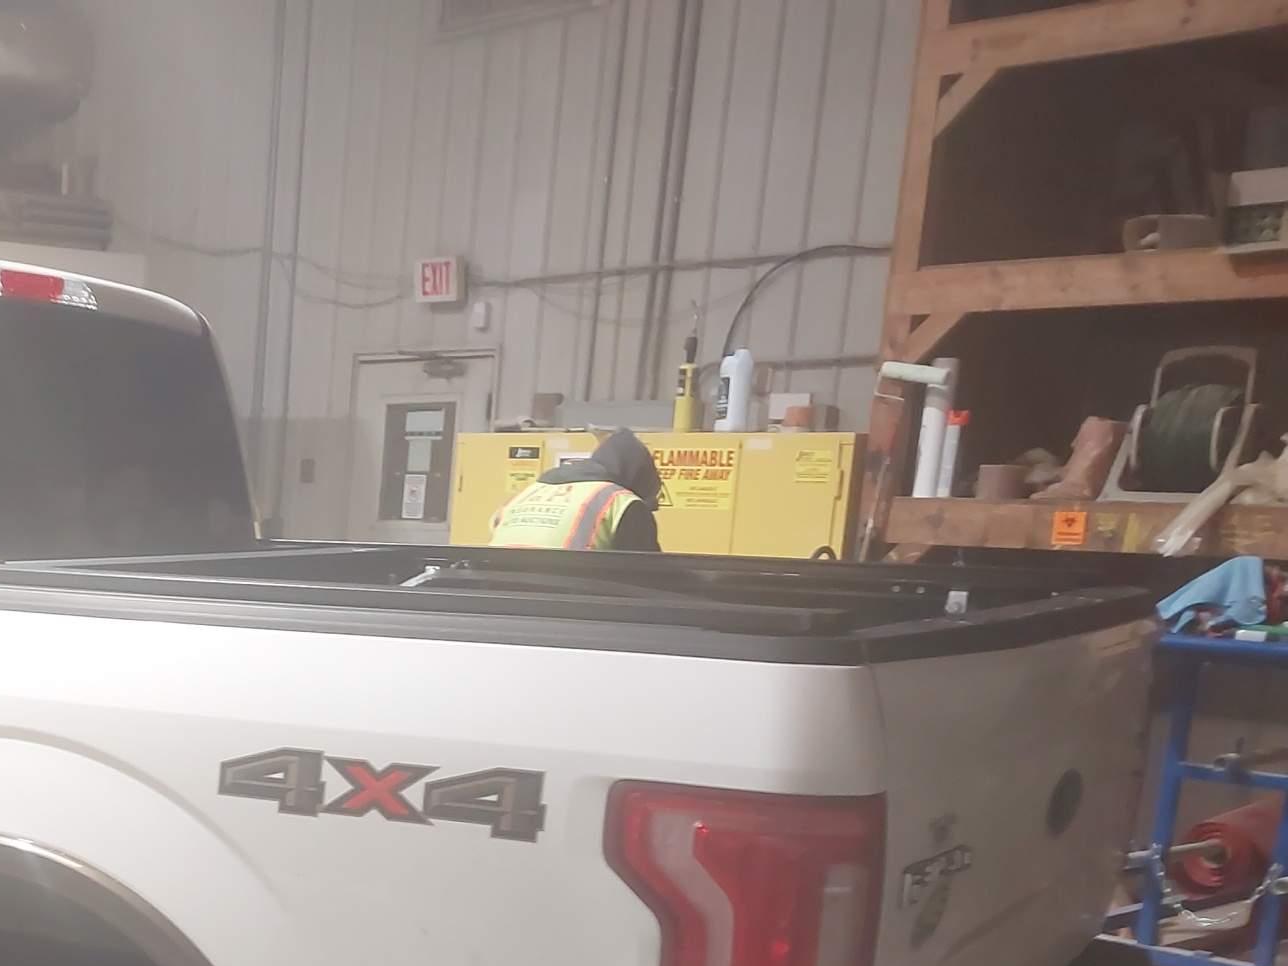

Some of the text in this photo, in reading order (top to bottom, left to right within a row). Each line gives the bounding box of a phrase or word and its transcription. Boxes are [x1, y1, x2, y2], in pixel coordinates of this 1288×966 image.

[421, 261, 451, 296] EXIT
[654, 449, 735, 467] FLAMMABLE
[657, 468, 732, 480] EEP FIRE AWAY
